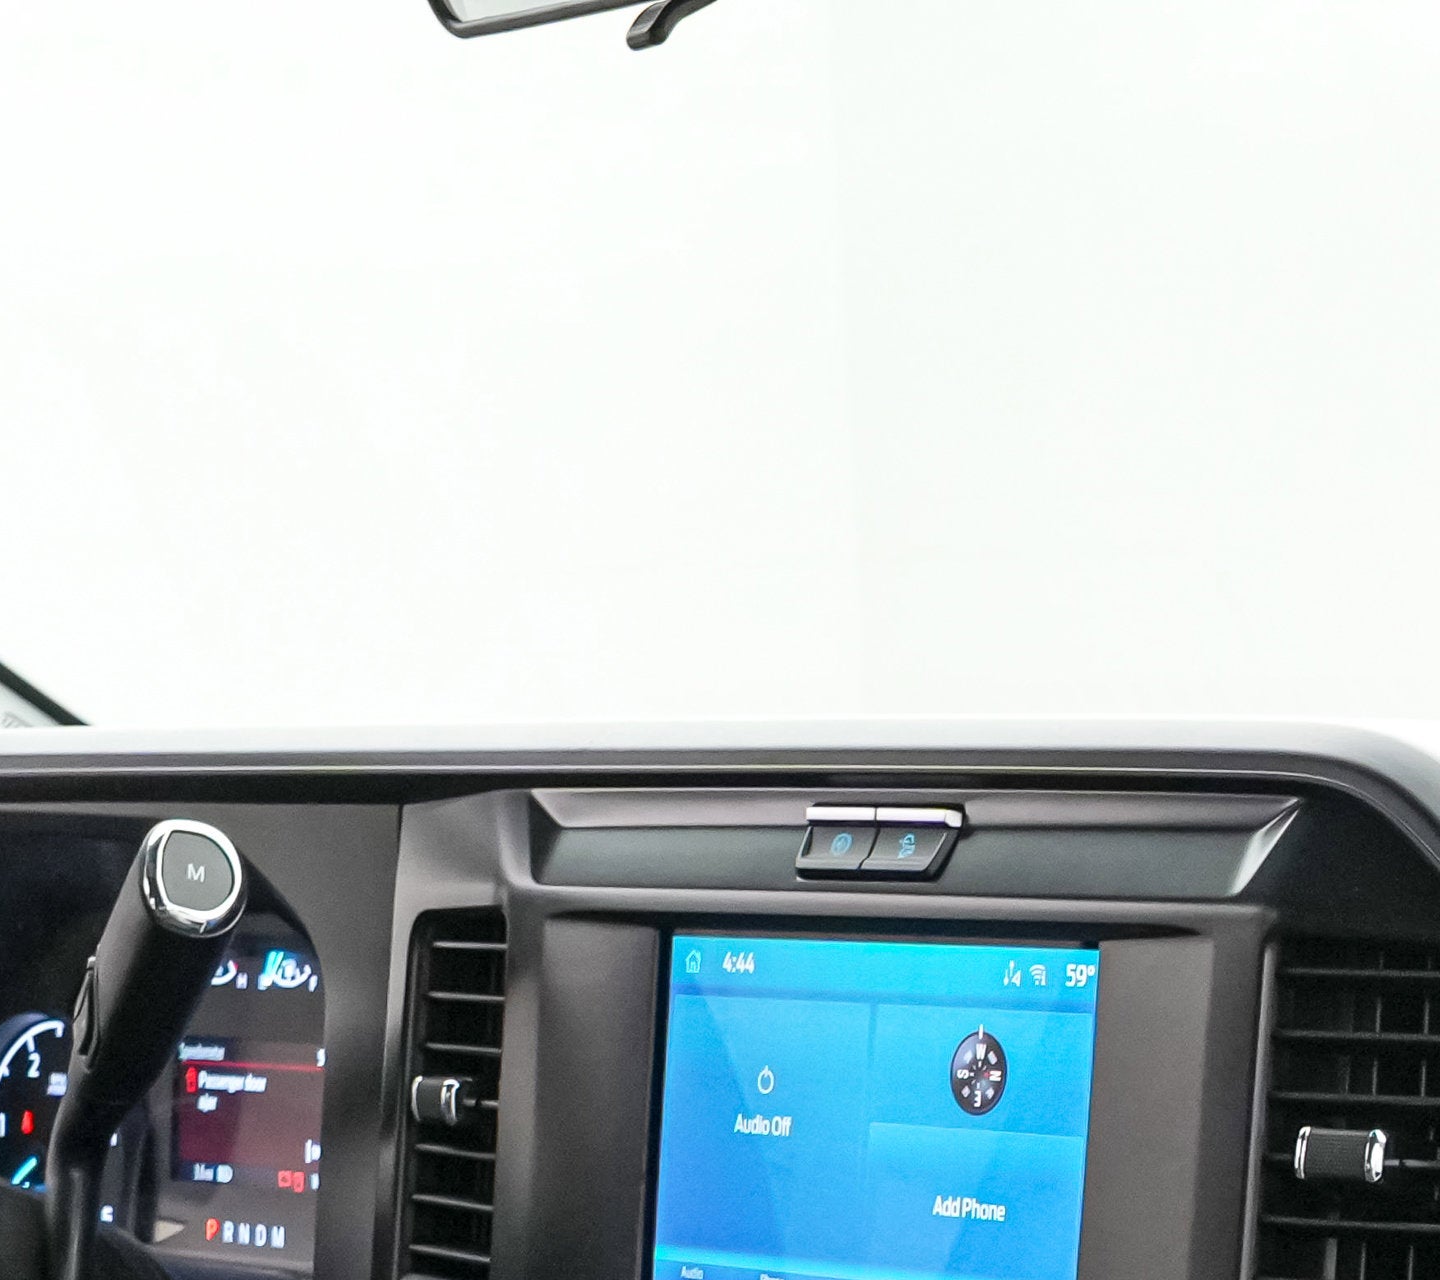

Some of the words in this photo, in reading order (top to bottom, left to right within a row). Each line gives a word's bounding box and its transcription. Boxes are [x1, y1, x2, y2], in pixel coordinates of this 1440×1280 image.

[187, 863, 206, 883] M
[722, 951, 756, 974] 4:44
[976, 1043, 987, 1061] W
[27, 1052, 41, 1078] 2
[733, 1113, 770, 1136] Audio
[771, 1116, 793, 1137] Off
[932, 1195, 961, 1217] Add
[961, 1197, 1006, 1222] Phone
[205, 1218, 220, 1241] P
[221, 1220, 234, 1244] R
[237, 1222, 250, 1246] N
[253, 1223, 267, 1248] D
[270, 1225, 285, 1249] M
[680, 1265, 705, 1280] Audio
